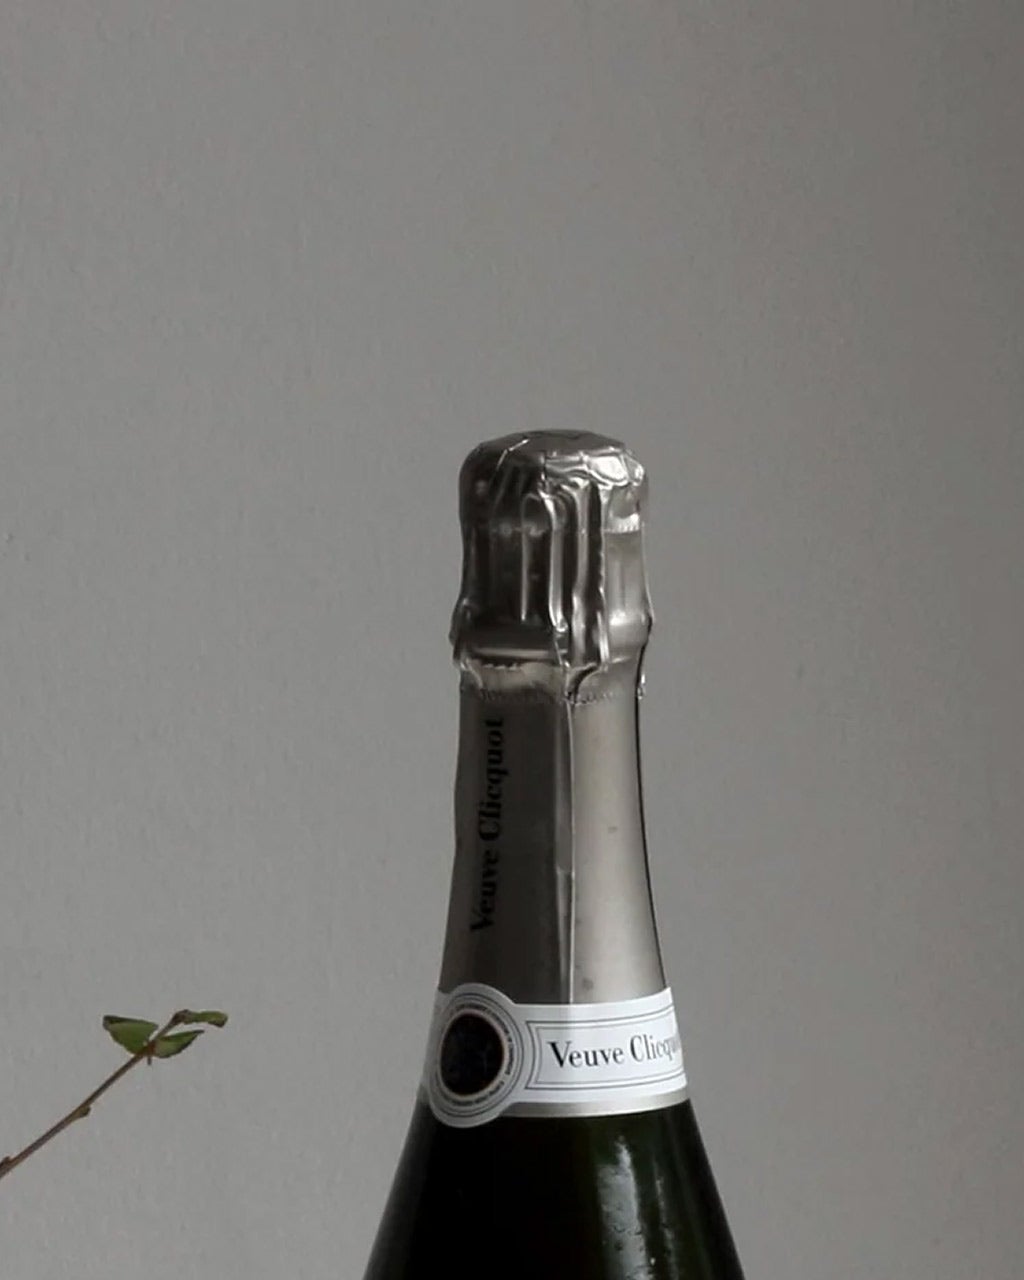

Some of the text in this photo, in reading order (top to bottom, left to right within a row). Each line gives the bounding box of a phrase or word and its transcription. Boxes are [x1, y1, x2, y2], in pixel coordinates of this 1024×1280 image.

[470, 716, 510, 932] Veuve Clicquot
[547, 1040, 625, 1068] Veuve
